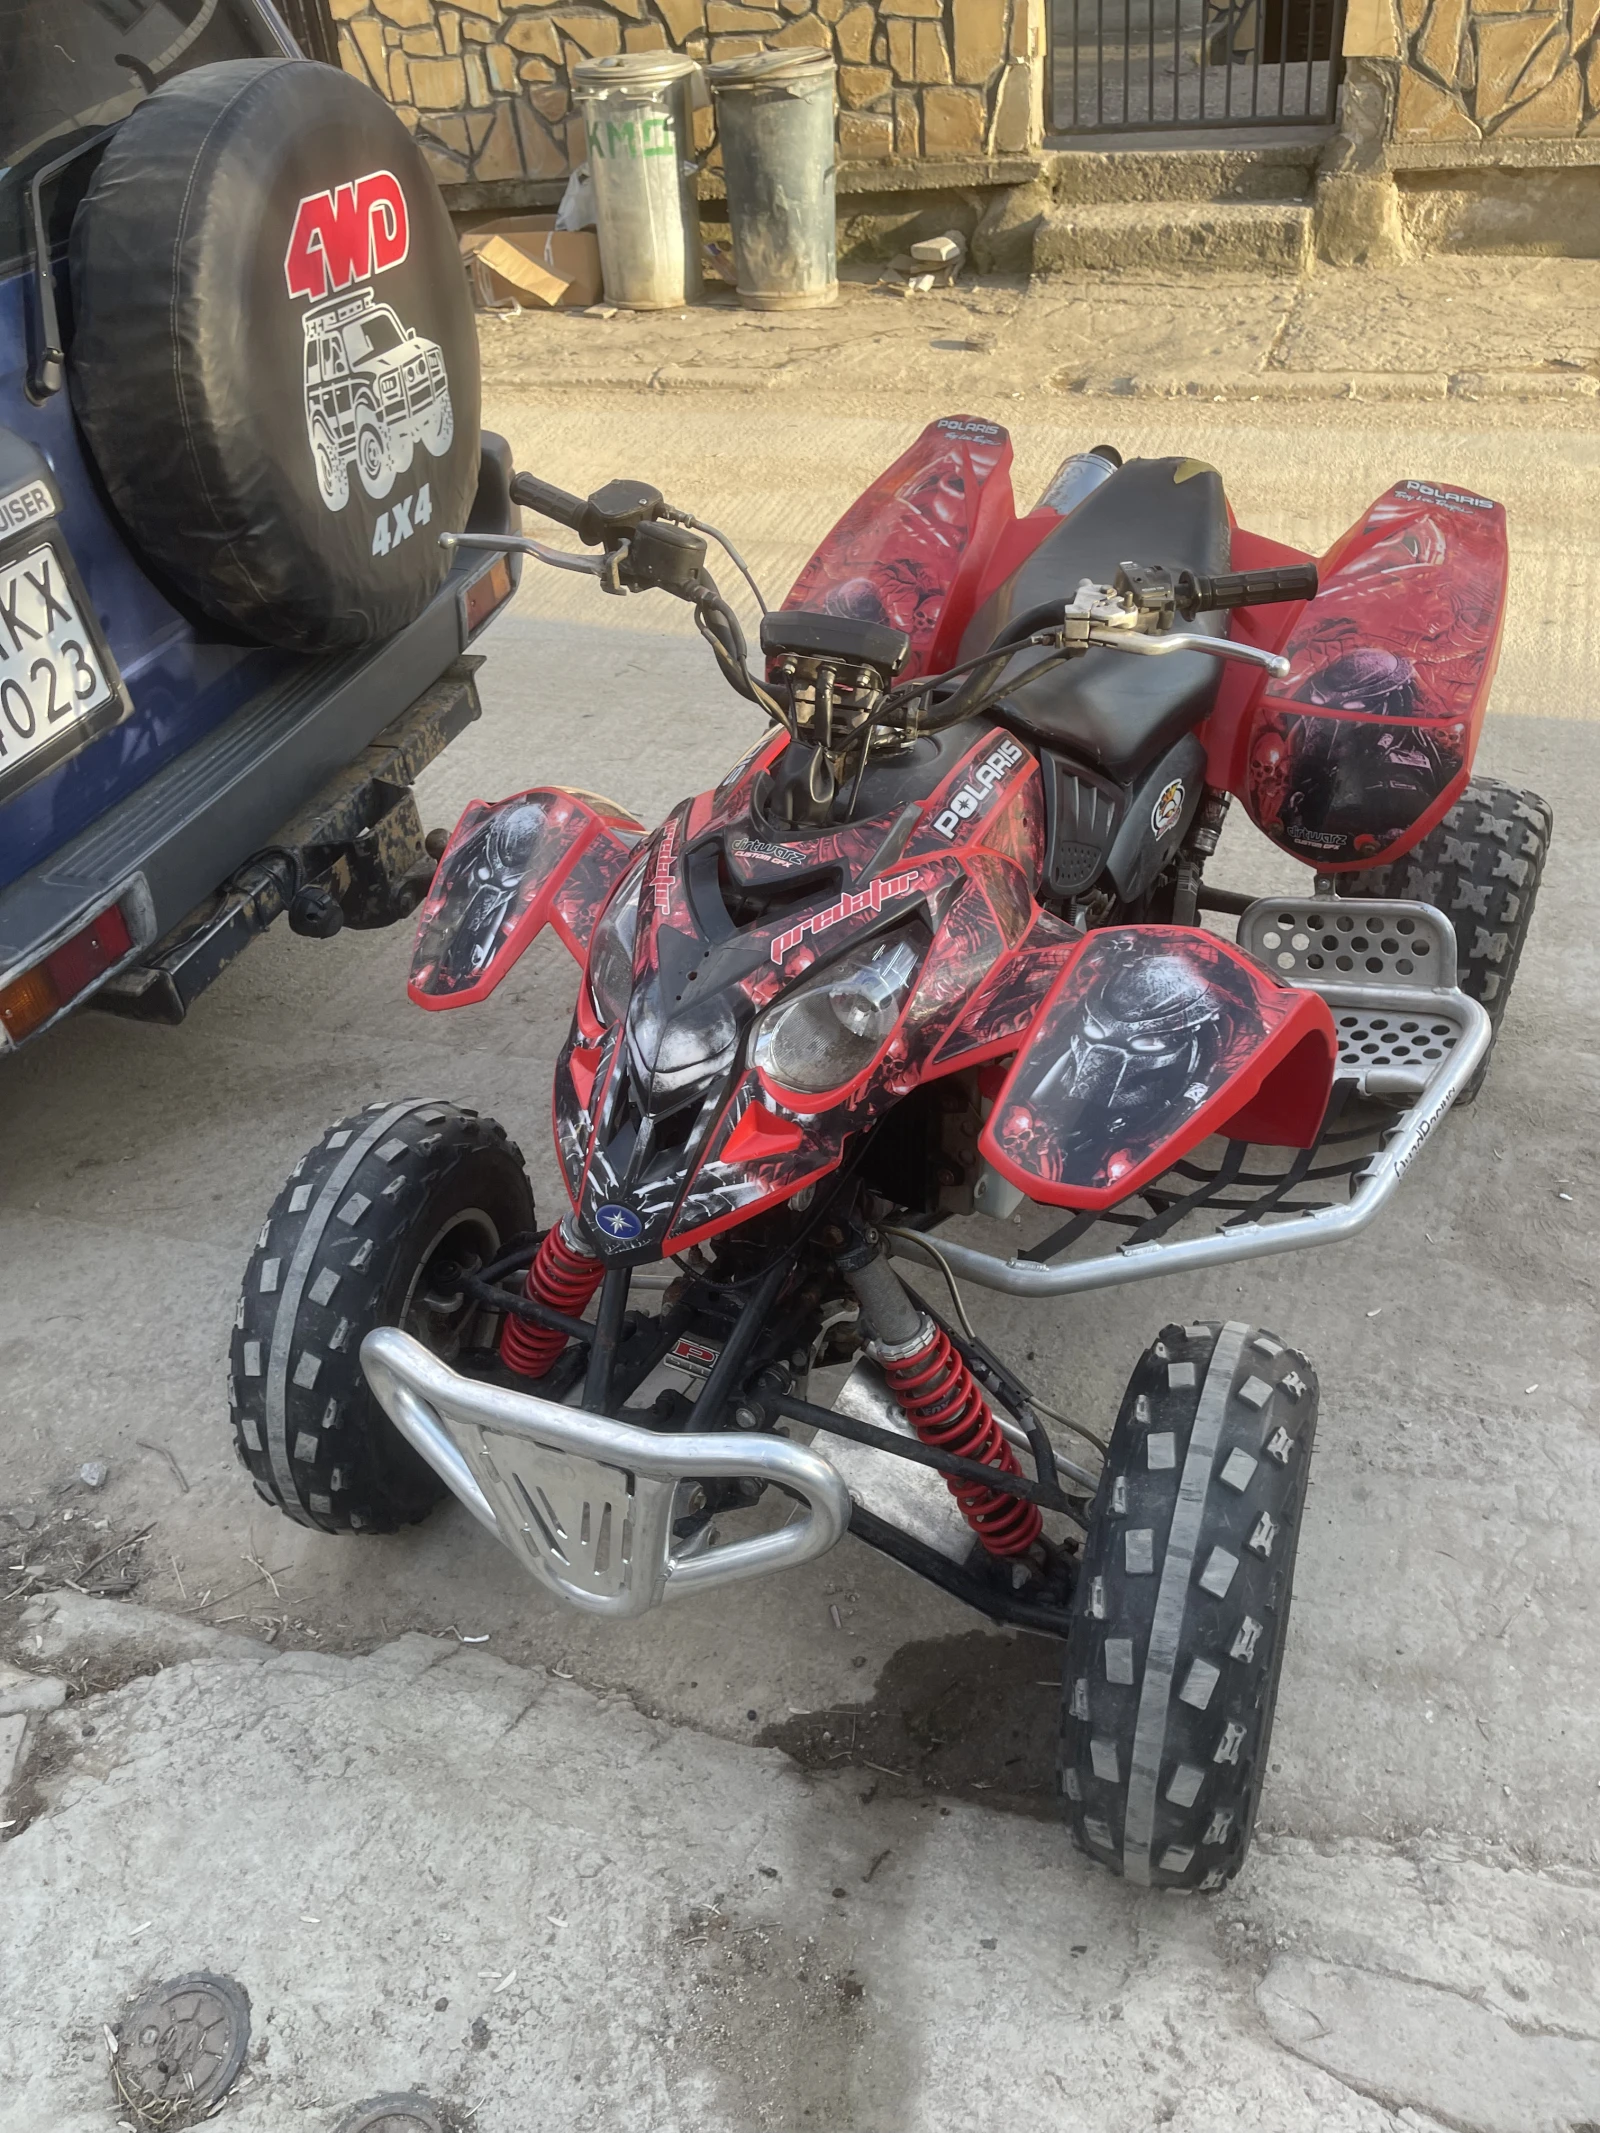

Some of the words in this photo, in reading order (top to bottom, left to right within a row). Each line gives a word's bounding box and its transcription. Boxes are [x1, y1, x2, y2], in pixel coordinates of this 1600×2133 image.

[284, 170, 410, 303] 4WD
[937, 420, 1000, 435] POLARIS
[1406, 481, 1494, 509] POLARIS
[0, 560, 72, 662] KX
[0, 640, 97, 757] 023
[933, 739, 1023, 840] POLARIS
[732, 838, 807, 865] dirtwarz
[734, 850, 772, 862] CUSTOM
[771, 870, 919, 965] predator
